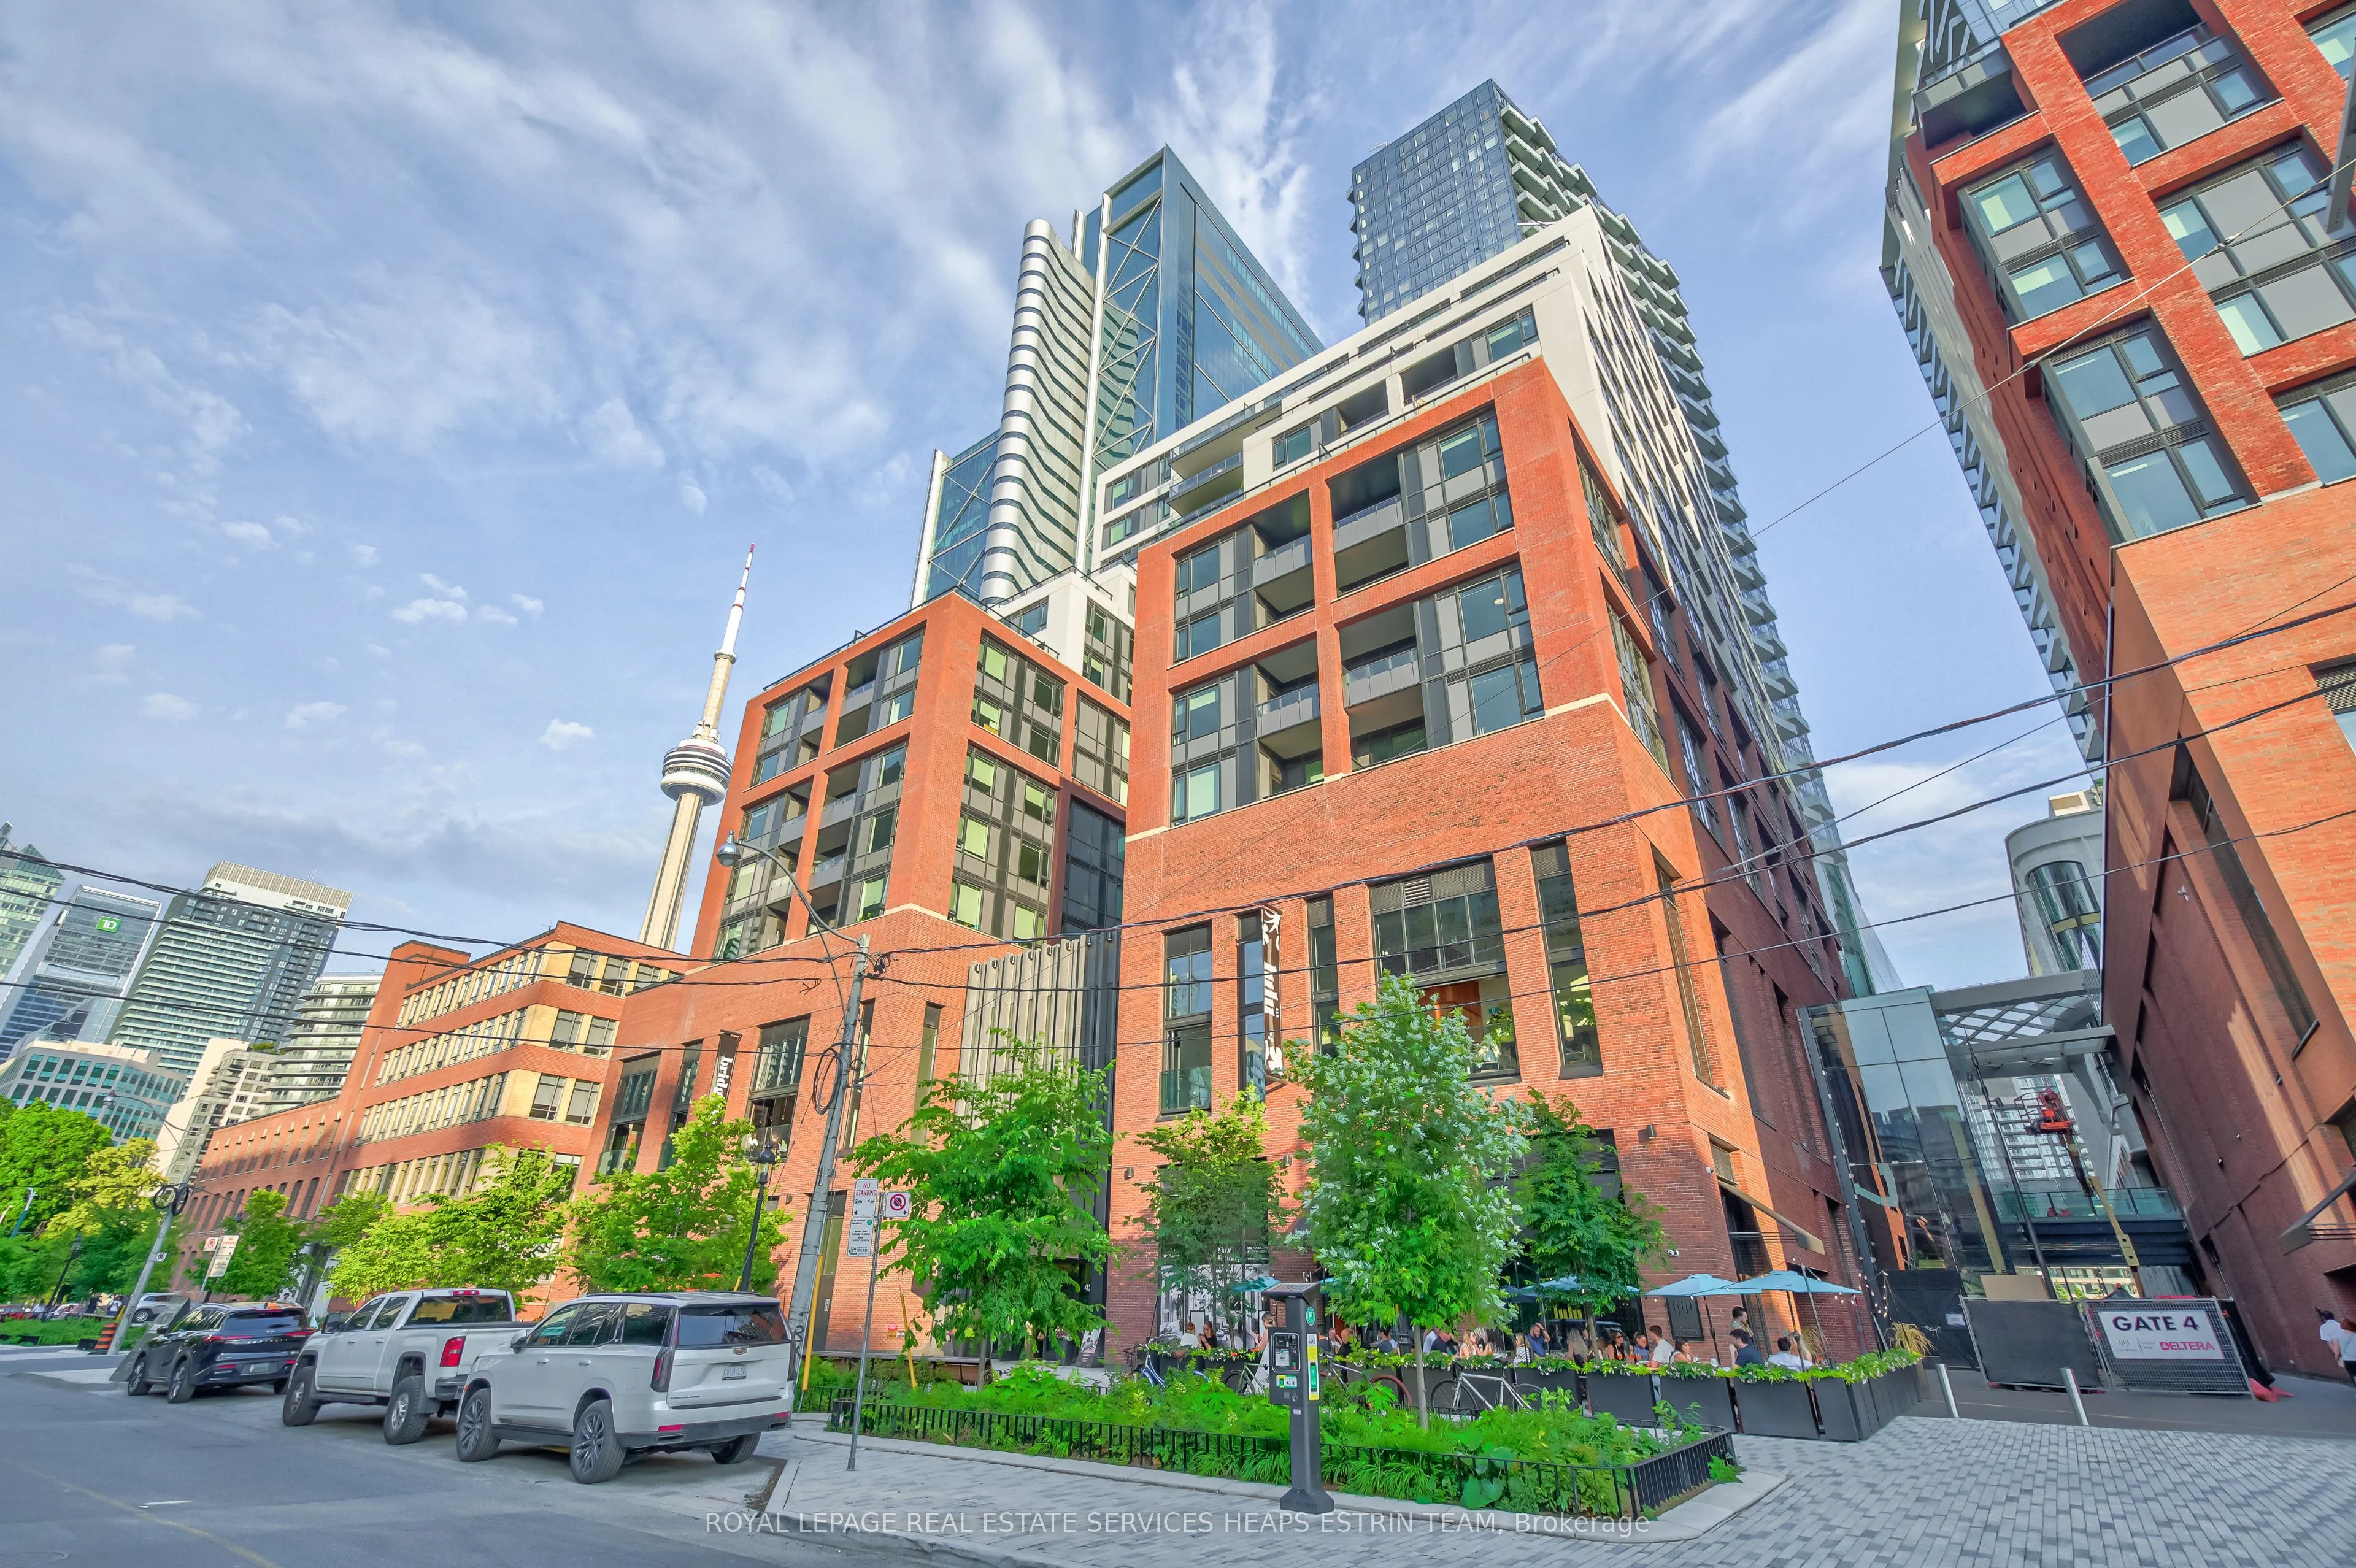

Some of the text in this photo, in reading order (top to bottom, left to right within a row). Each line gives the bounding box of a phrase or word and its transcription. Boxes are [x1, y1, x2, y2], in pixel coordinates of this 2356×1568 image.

[102, 920, 117, 929] TD
[2112, 1316, 2200, 1331] GATE 4
[2159, 1342, 2215, 1350] DELTERA
